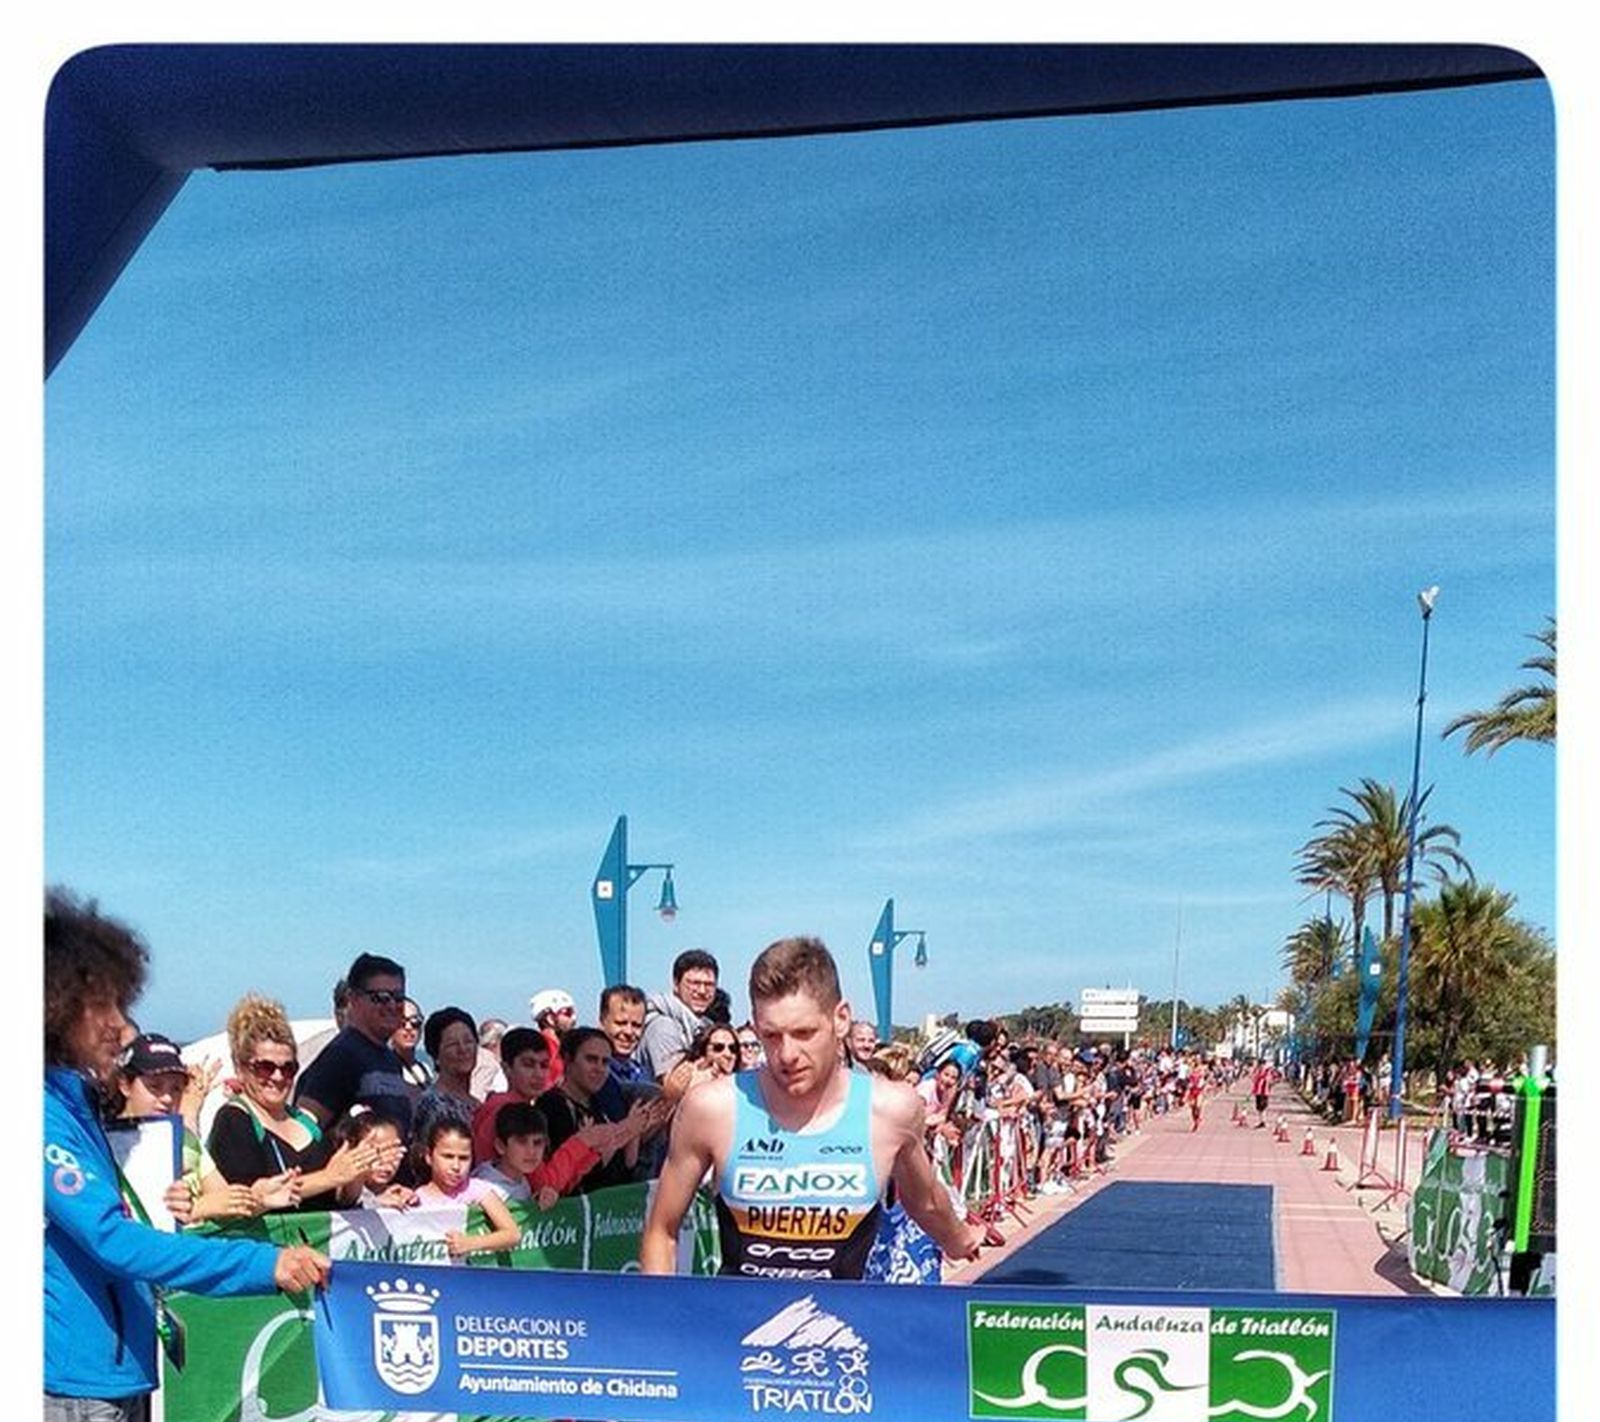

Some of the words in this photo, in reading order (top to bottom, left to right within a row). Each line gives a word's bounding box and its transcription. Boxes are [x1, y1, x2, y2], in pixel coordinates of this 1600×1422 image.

[738, 1171, 859, 1193] FANOX
[748, 1206, 849, 1236] PUERTAS
[740, 1263, 833, 1279] ORBEA
[456, 1315, 560, 1336] DELEGACION
[566, 1318, 588, 1337] DE
[974, 1309, 1085, 1331] Federación
[1095, 1314, 1204, 1333] Andaluza
[1211, 1316, 1237, 1335] de
[1241, 1316, 1330, 1337] Triatlón
[457, 1335, 569, 1360] DEPORTES
[459, 1374, 578, 1395] Ayuntamiento
[581, 1378, 602, 1395] de
